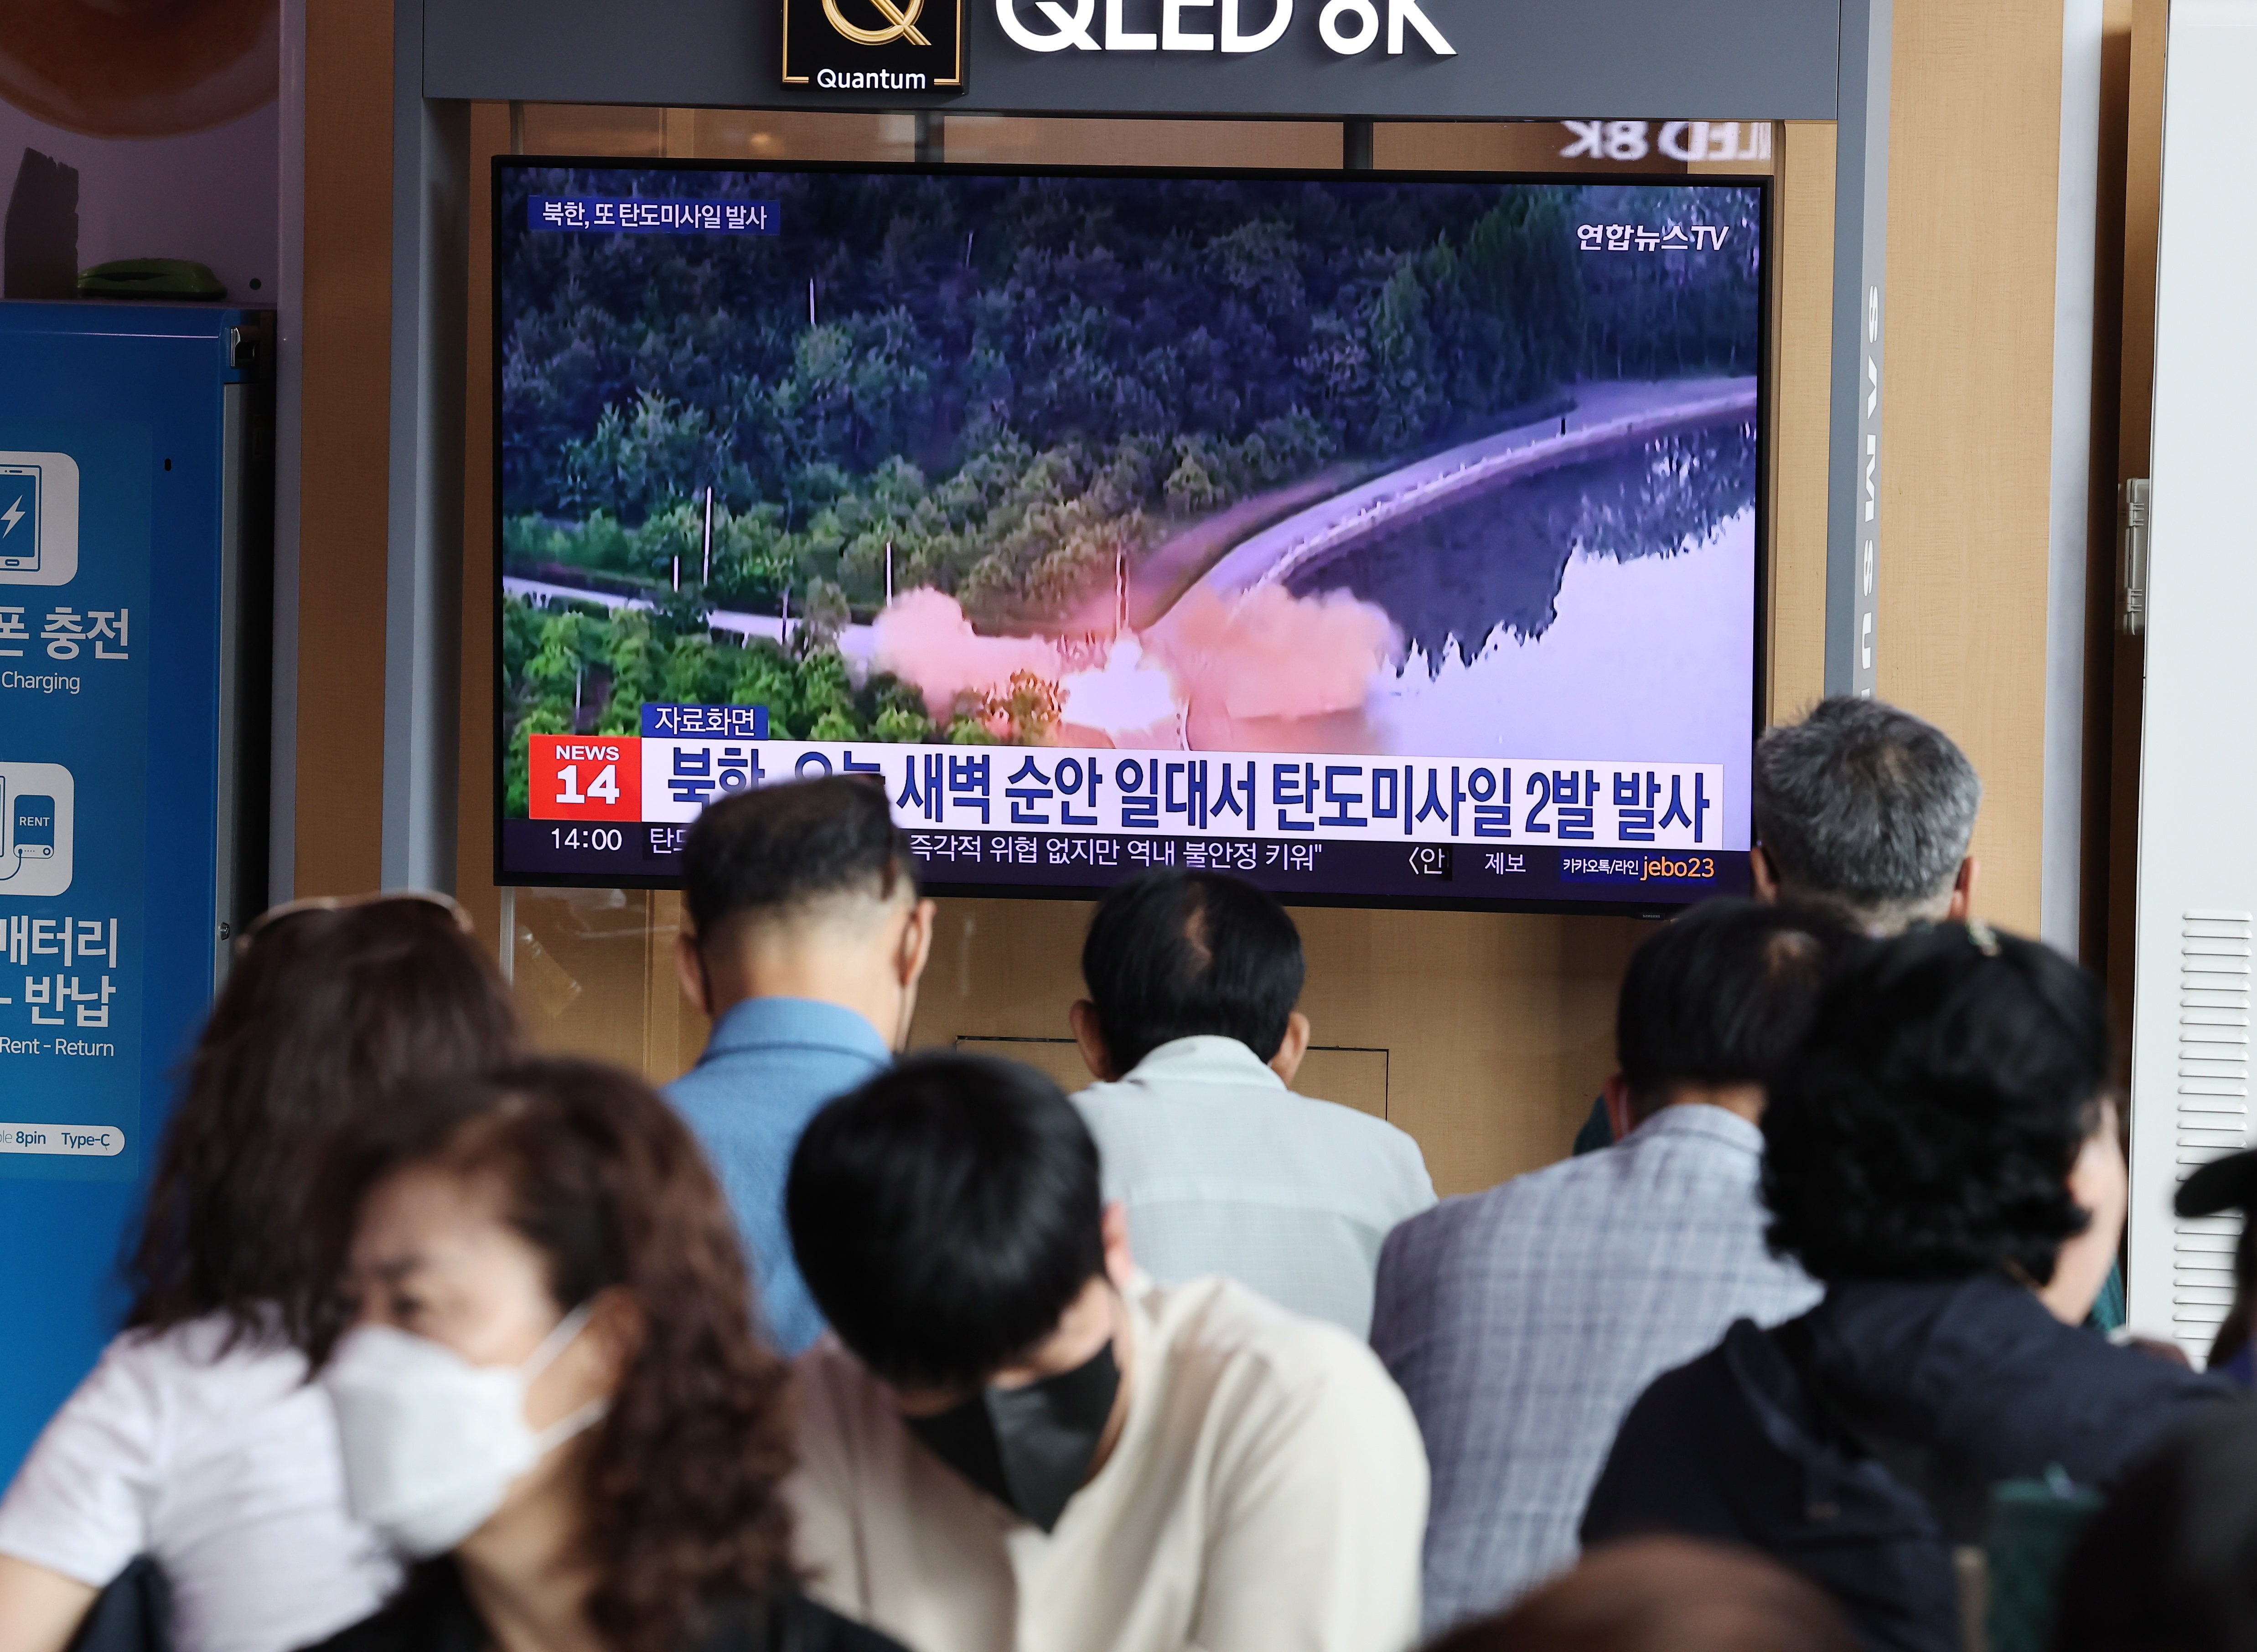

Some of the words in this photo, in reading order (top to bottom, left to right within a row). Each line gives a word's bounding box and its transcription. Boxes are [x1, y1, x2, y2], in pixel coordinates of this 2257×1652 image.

[817, 68, 926, 89] Quantum
[543, 201, 590, 229] 북한,
[594, 205, 615, 225] 또
[619, 203, 721, 229] 탄도미사일
[726, 205, 767, 229] 발사
[1577, 224, 1729, 252] 연합뉴스TV
[1861, 285, 1879, 698] SAMSU
[41, 607, 129, 660] 충전
[1, 671, 80, 694] Charging
[655, 706, 755, 737] 자료화면
[556, 745, 620, 760] NEWS
[555, 764, 620, 805] 14
[896, 753, 990, 824] 새벽
[1005, 755, 1103, 826] 순안
[1115, 758, 1256, 831] 일대서
[1273, 763, 1512, 837] 탄도미사일
[1526, 770, 1600, 840] 2발
[1613, 771, 1710, 843] 발사
[19, 816, 50, 826] RENT
[551, 827, 622, 851] 14:00
[910, 835, 981, 862] 즉각적
[990, 836, 1037, 863] 위협
[1046, 838, 1120, 865] 없지만
[1128, 840, 1175, 867] 역내
[1183, 841, 1257, 870] 불안정
[1485, 852, 1526, 875] 제보
[1563, 858, 1639, 875] 카카오톡/라인
[1640, 856, 1714, 881] jebo23
[25, 974, 116, 1027] 반납
[0, 1037, 40, 1054] Rent
[55, 1038, 114, 1057] Return
[16, 1131, 46, 1147] 8pin
[61, 1132, 110, 1149] Type-C
